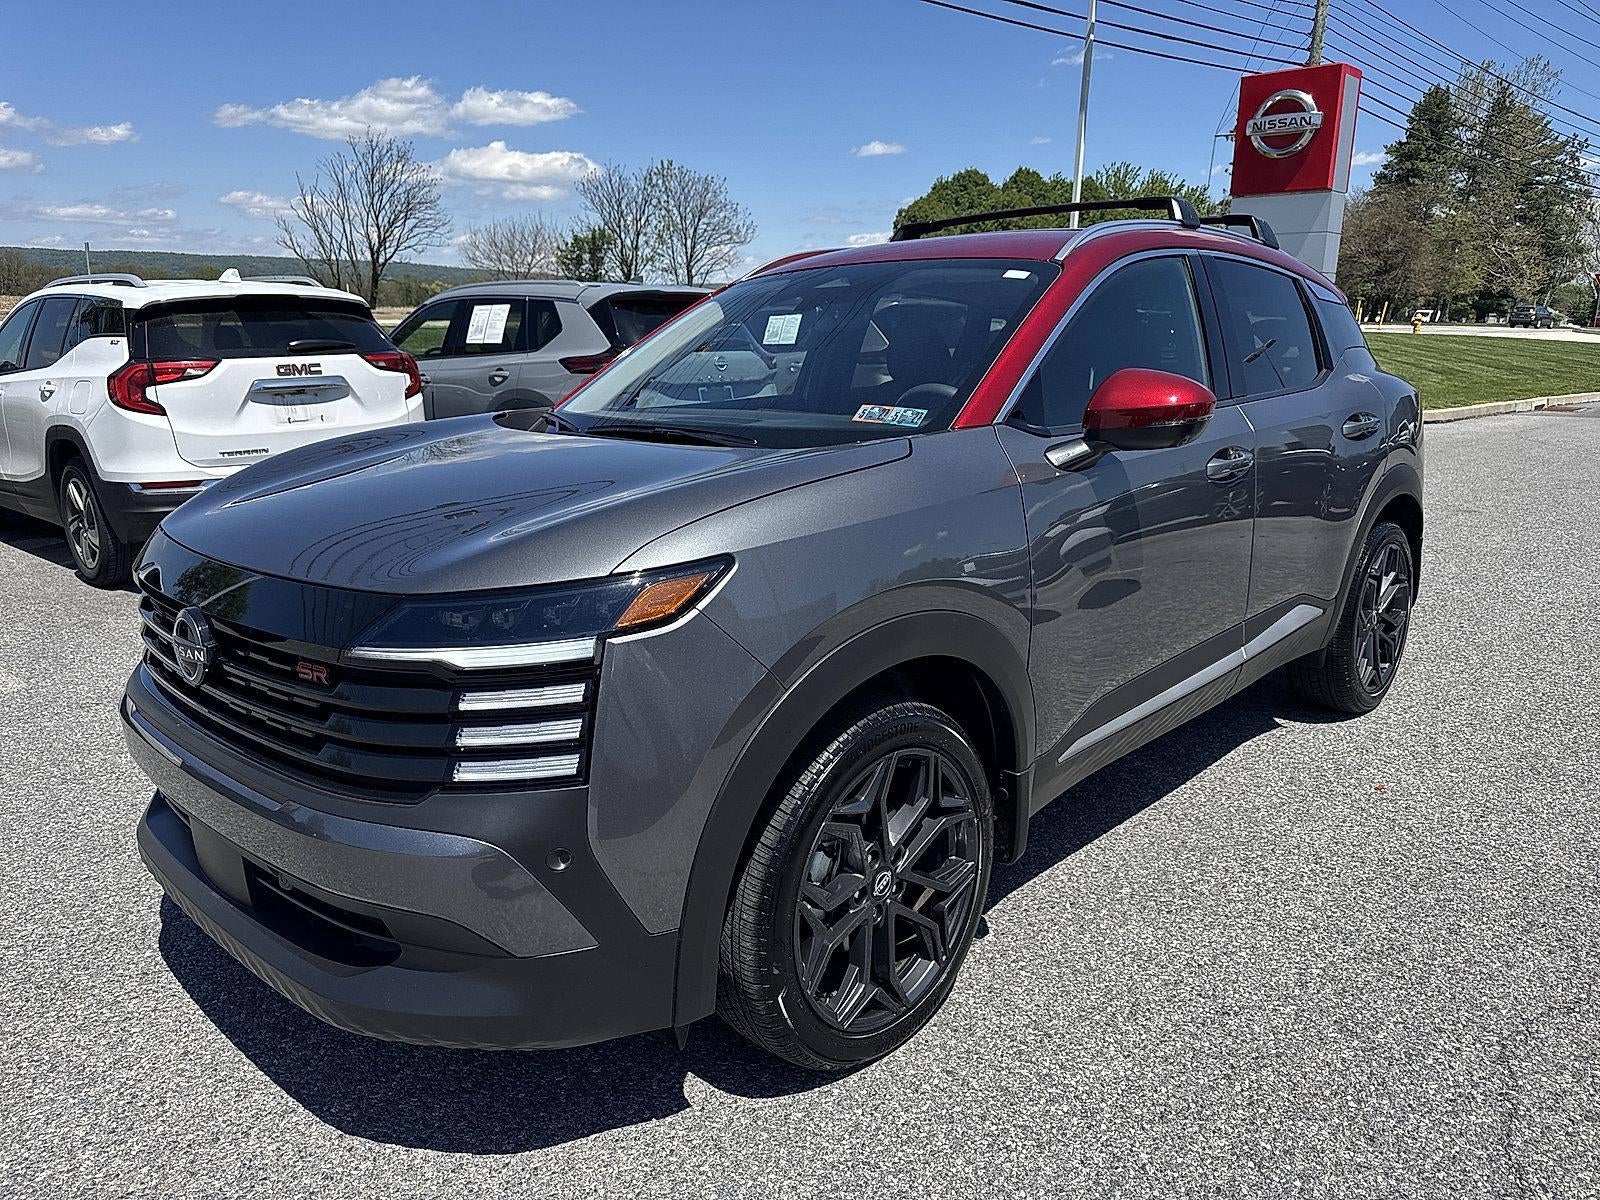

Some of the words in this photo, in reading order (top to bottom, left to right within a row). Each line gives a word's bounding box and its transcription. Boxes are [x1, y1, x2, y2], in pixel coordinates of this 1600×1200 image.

[1252, 116, 1312, 132] NISSAN
[276, 363, 322, 376] GMC
[219, 447, 269, 457] TERRAIN
[298, 661, 328, 685] SR
